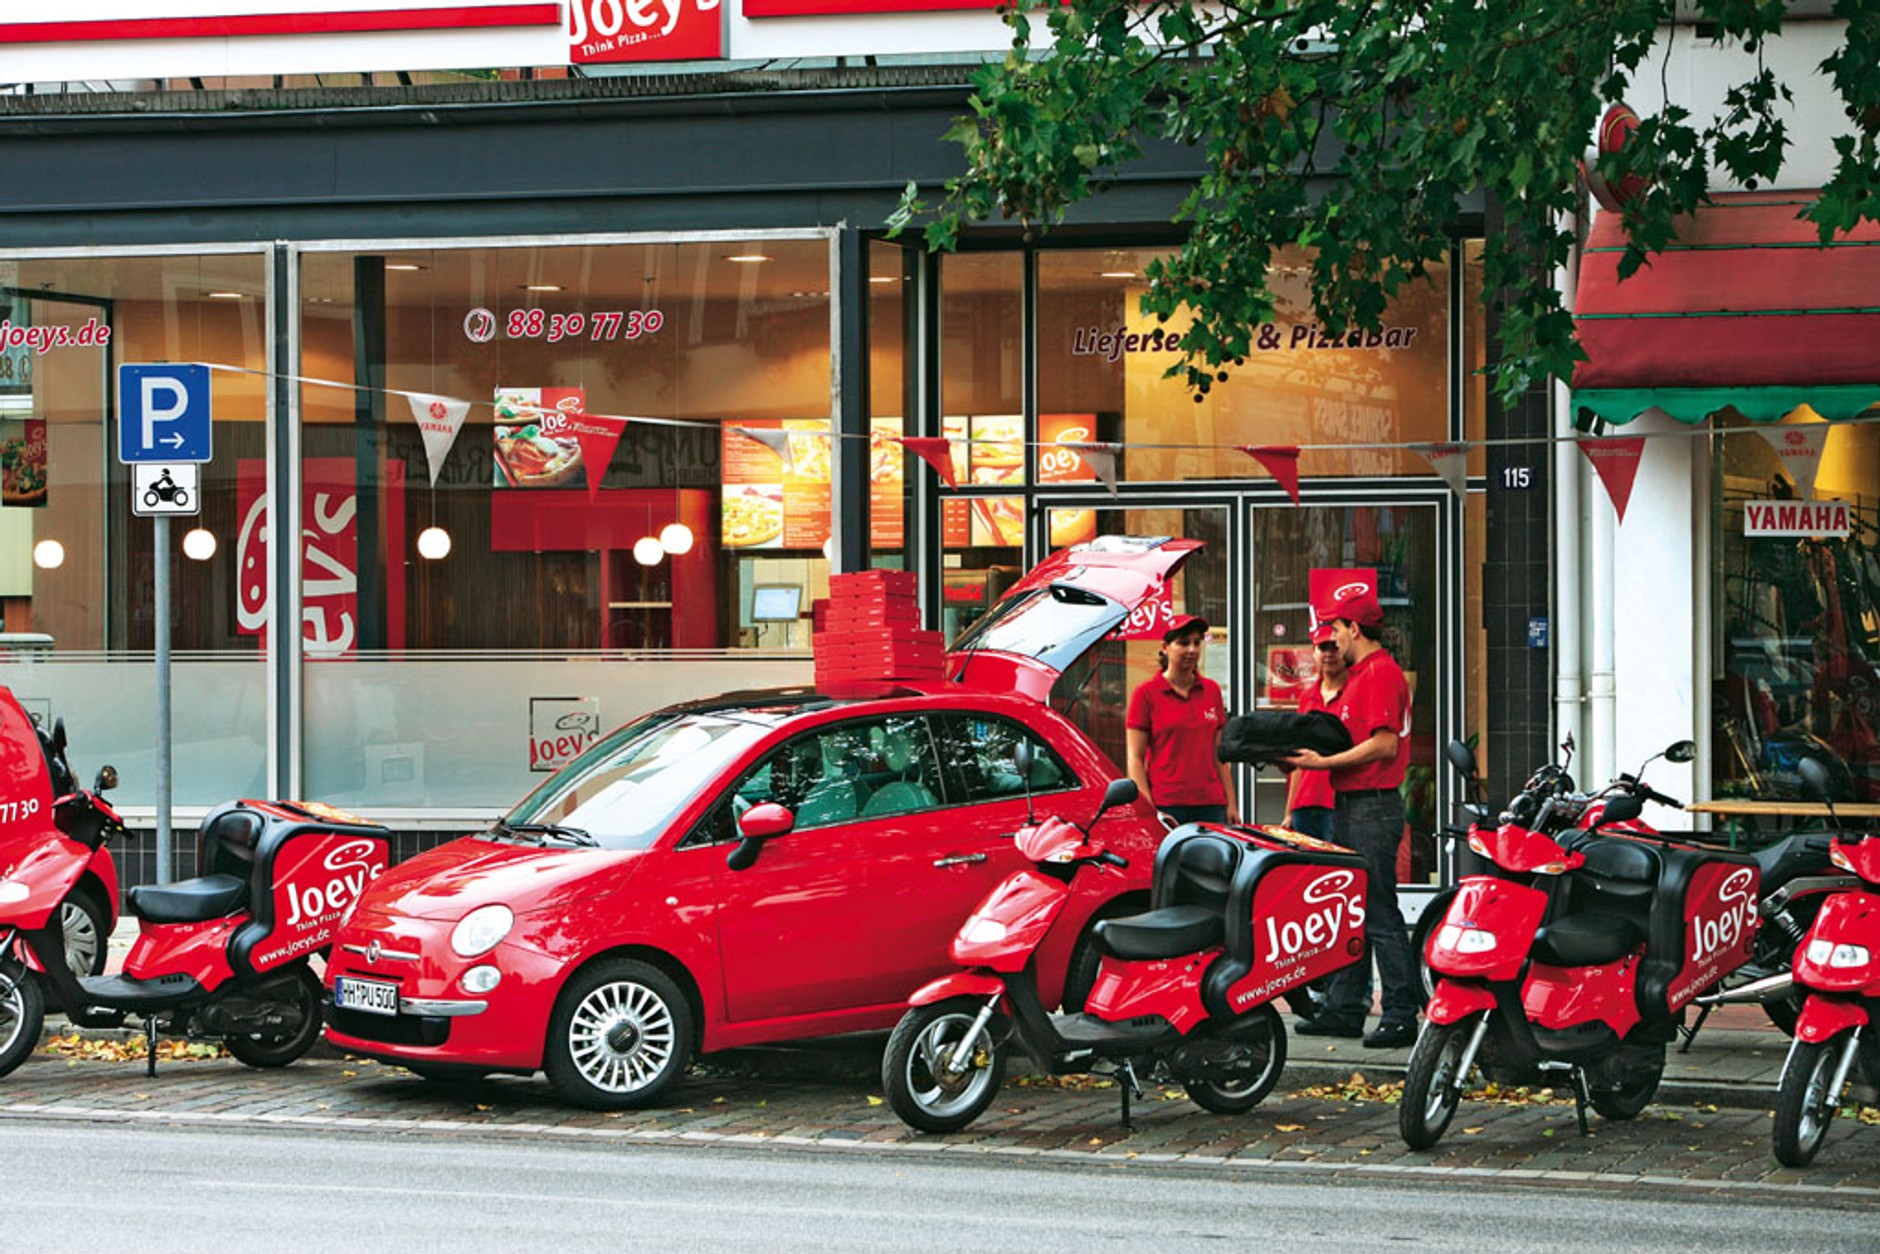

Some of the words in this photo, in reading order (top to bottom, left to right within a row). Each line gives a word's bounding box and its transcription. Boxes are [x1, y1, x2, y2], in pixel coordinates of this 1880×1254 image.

[581, 39, 614, 56] Think
[506, 308, 545, 339] 88
[547, 313, 585, 343] 30
[591, 311, 623, 341] 77
[625, 310, 664, 340] 30
[1257, 323, 1281, 349] &
[141, 376, 189, 449] P
[1503, 467, 1530, 488] 115
[1746, 505, 1849, 531] YAMAHA
[20, 797, 39, 820] 30
[296, 918, 319, 932] Think
[258, 929, 330, 965] www.joeys.de
[1274, 954, 1297, 970] Think
[1236, 965, 1307, 1005] www.joeys.de
